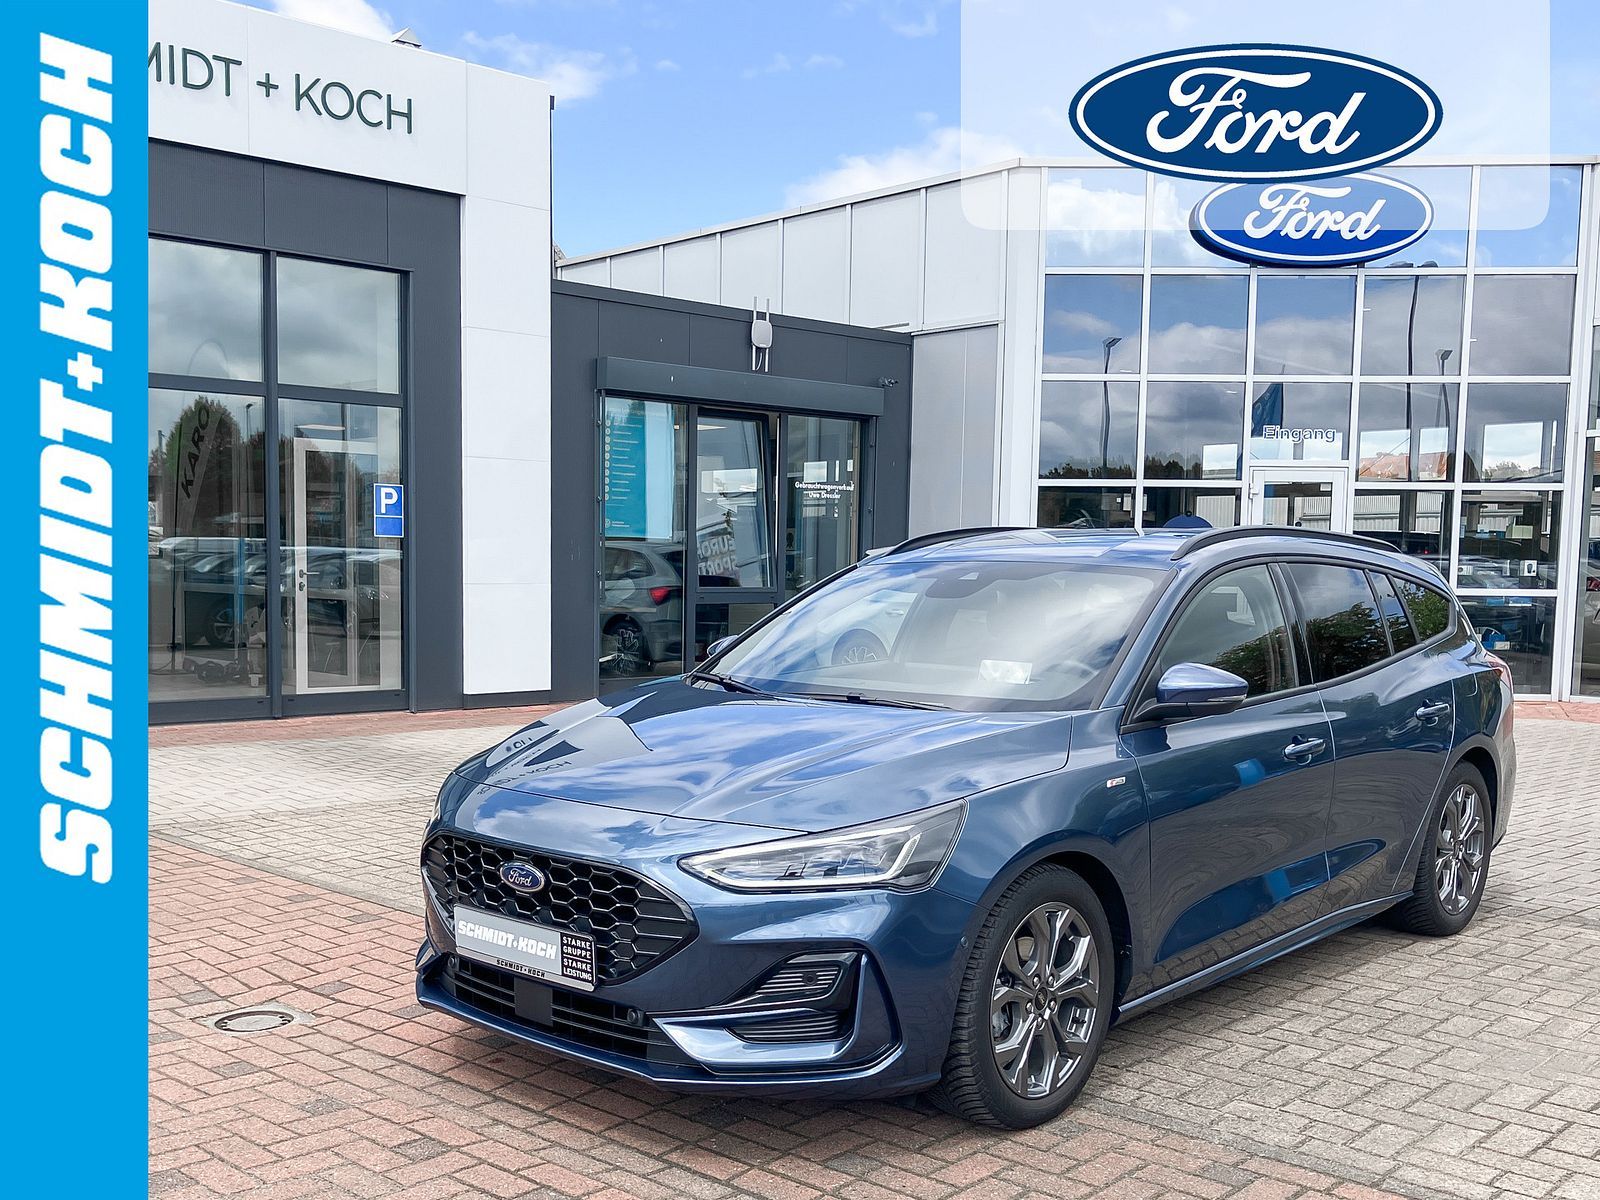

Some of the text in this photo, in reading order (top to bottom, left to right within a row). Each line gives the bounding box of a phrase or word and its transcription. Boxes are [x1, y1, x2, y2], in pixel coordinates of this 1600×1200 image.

[294, 73, 413, 135] KOCH
[1243, 182, 1387, 240] Ford
[1263, 425, 1337, 443] Eingang
[181, 406, 209, 498] KARO
[381, 487, 398, 513] P
[508, 868, 532, 886] Ford
[562, 936, 591, 950] STARKE
[562, 945, 592, 959] GRUPPE
[563, 958, 592, 972] STARKE
[563, 967, 592, 981] LEISTUNG
